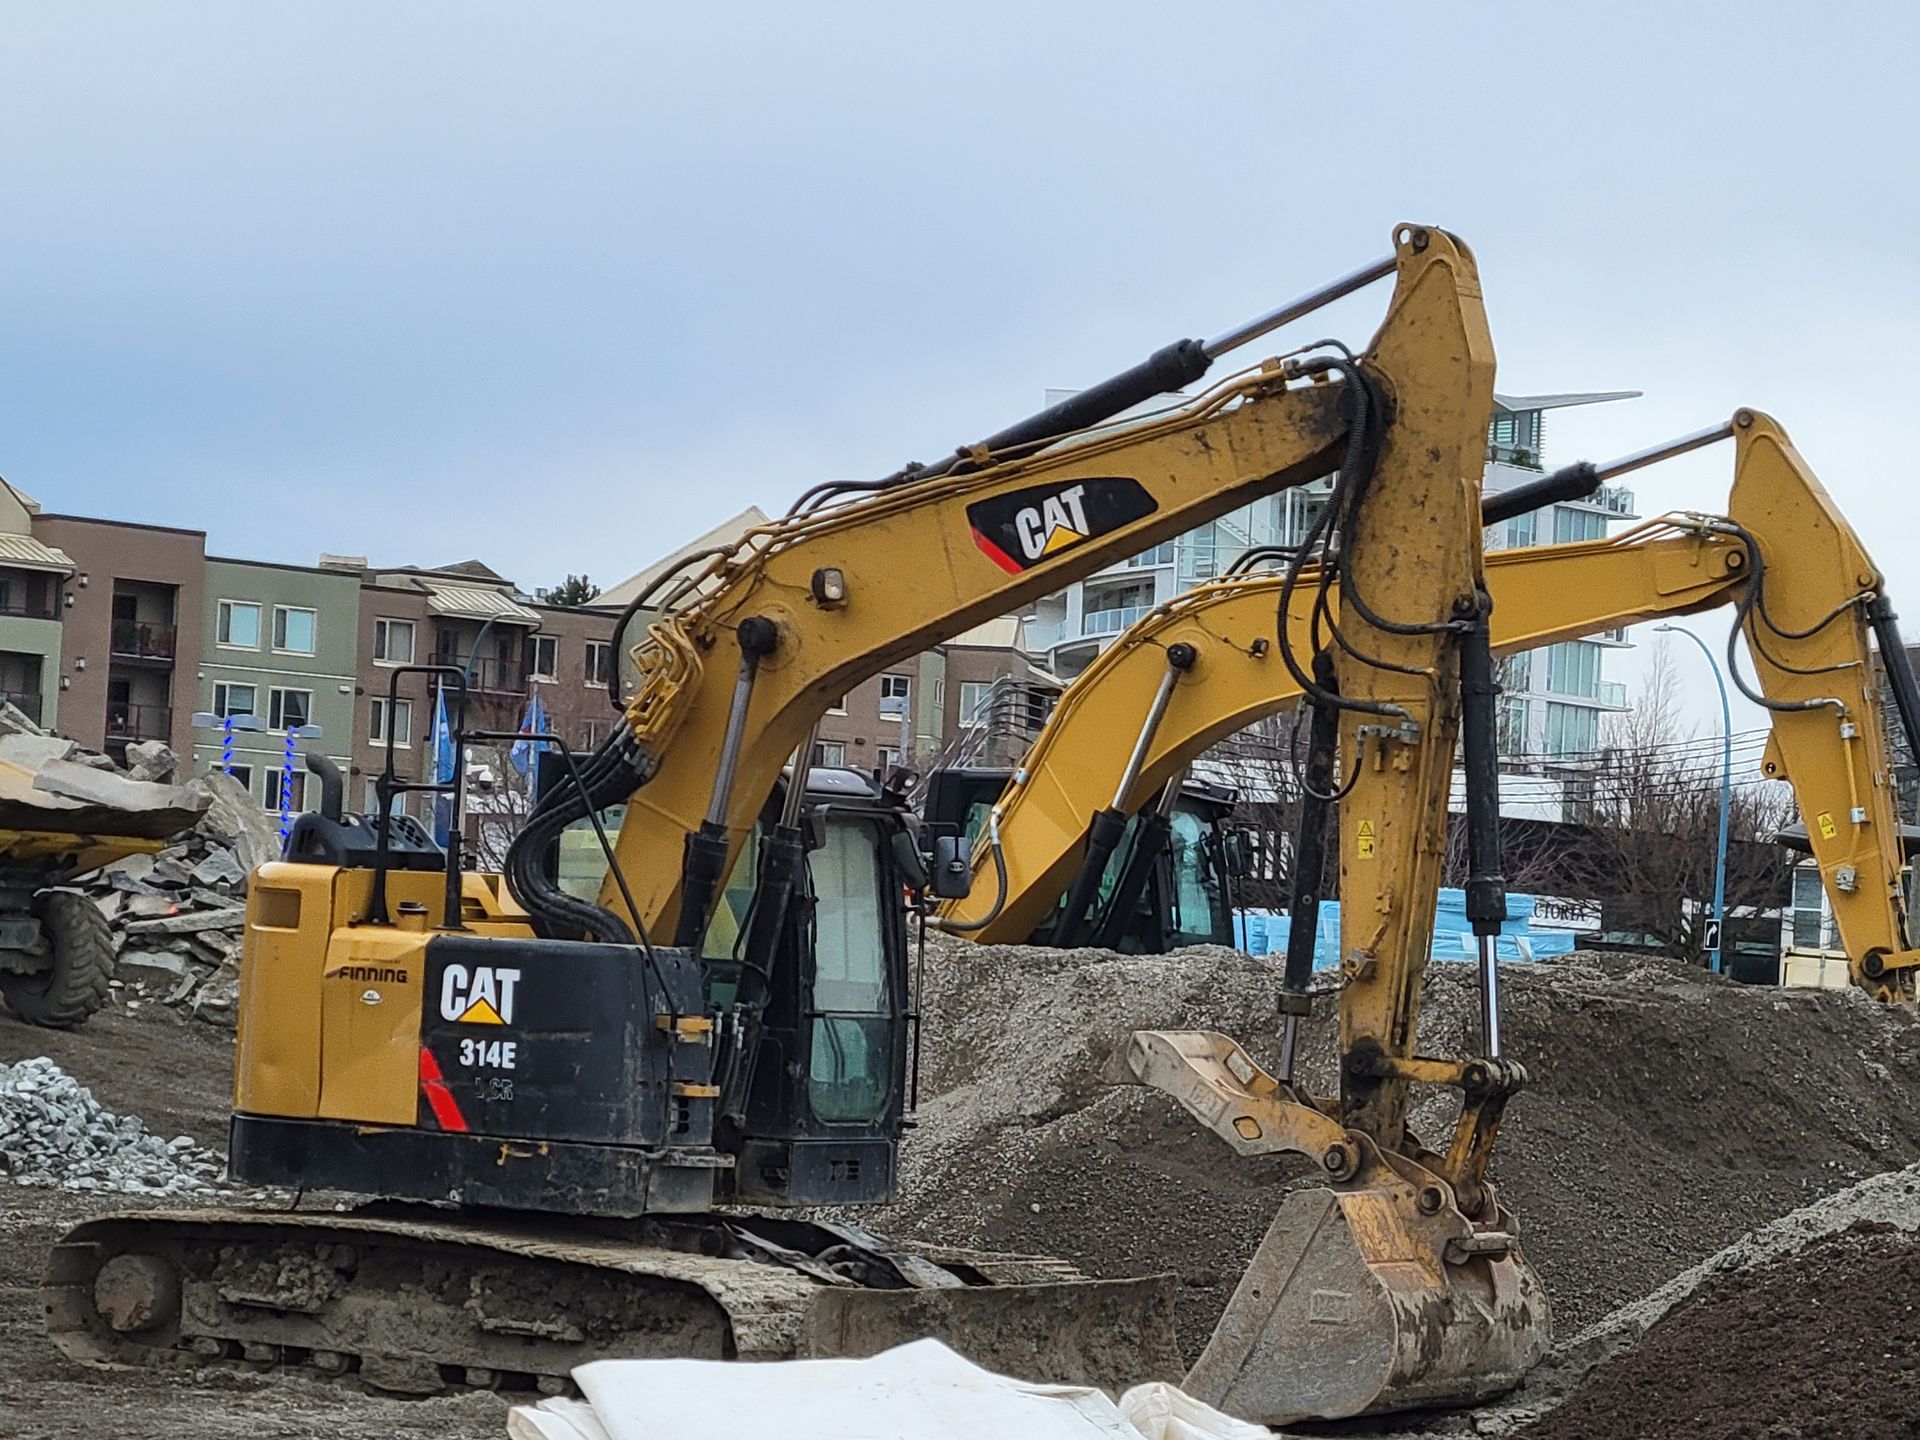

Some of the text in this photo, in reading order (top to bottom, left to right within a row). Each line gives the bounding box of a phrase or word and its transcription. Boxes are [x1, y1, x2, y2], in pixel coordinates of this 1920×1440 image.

[1015, 484, 1090, 559] CAT
[336, 966, 408, 983] FINNING
[440, 963, 521, 1025] CAT
[459, 1038, 517, 1069] 314E
